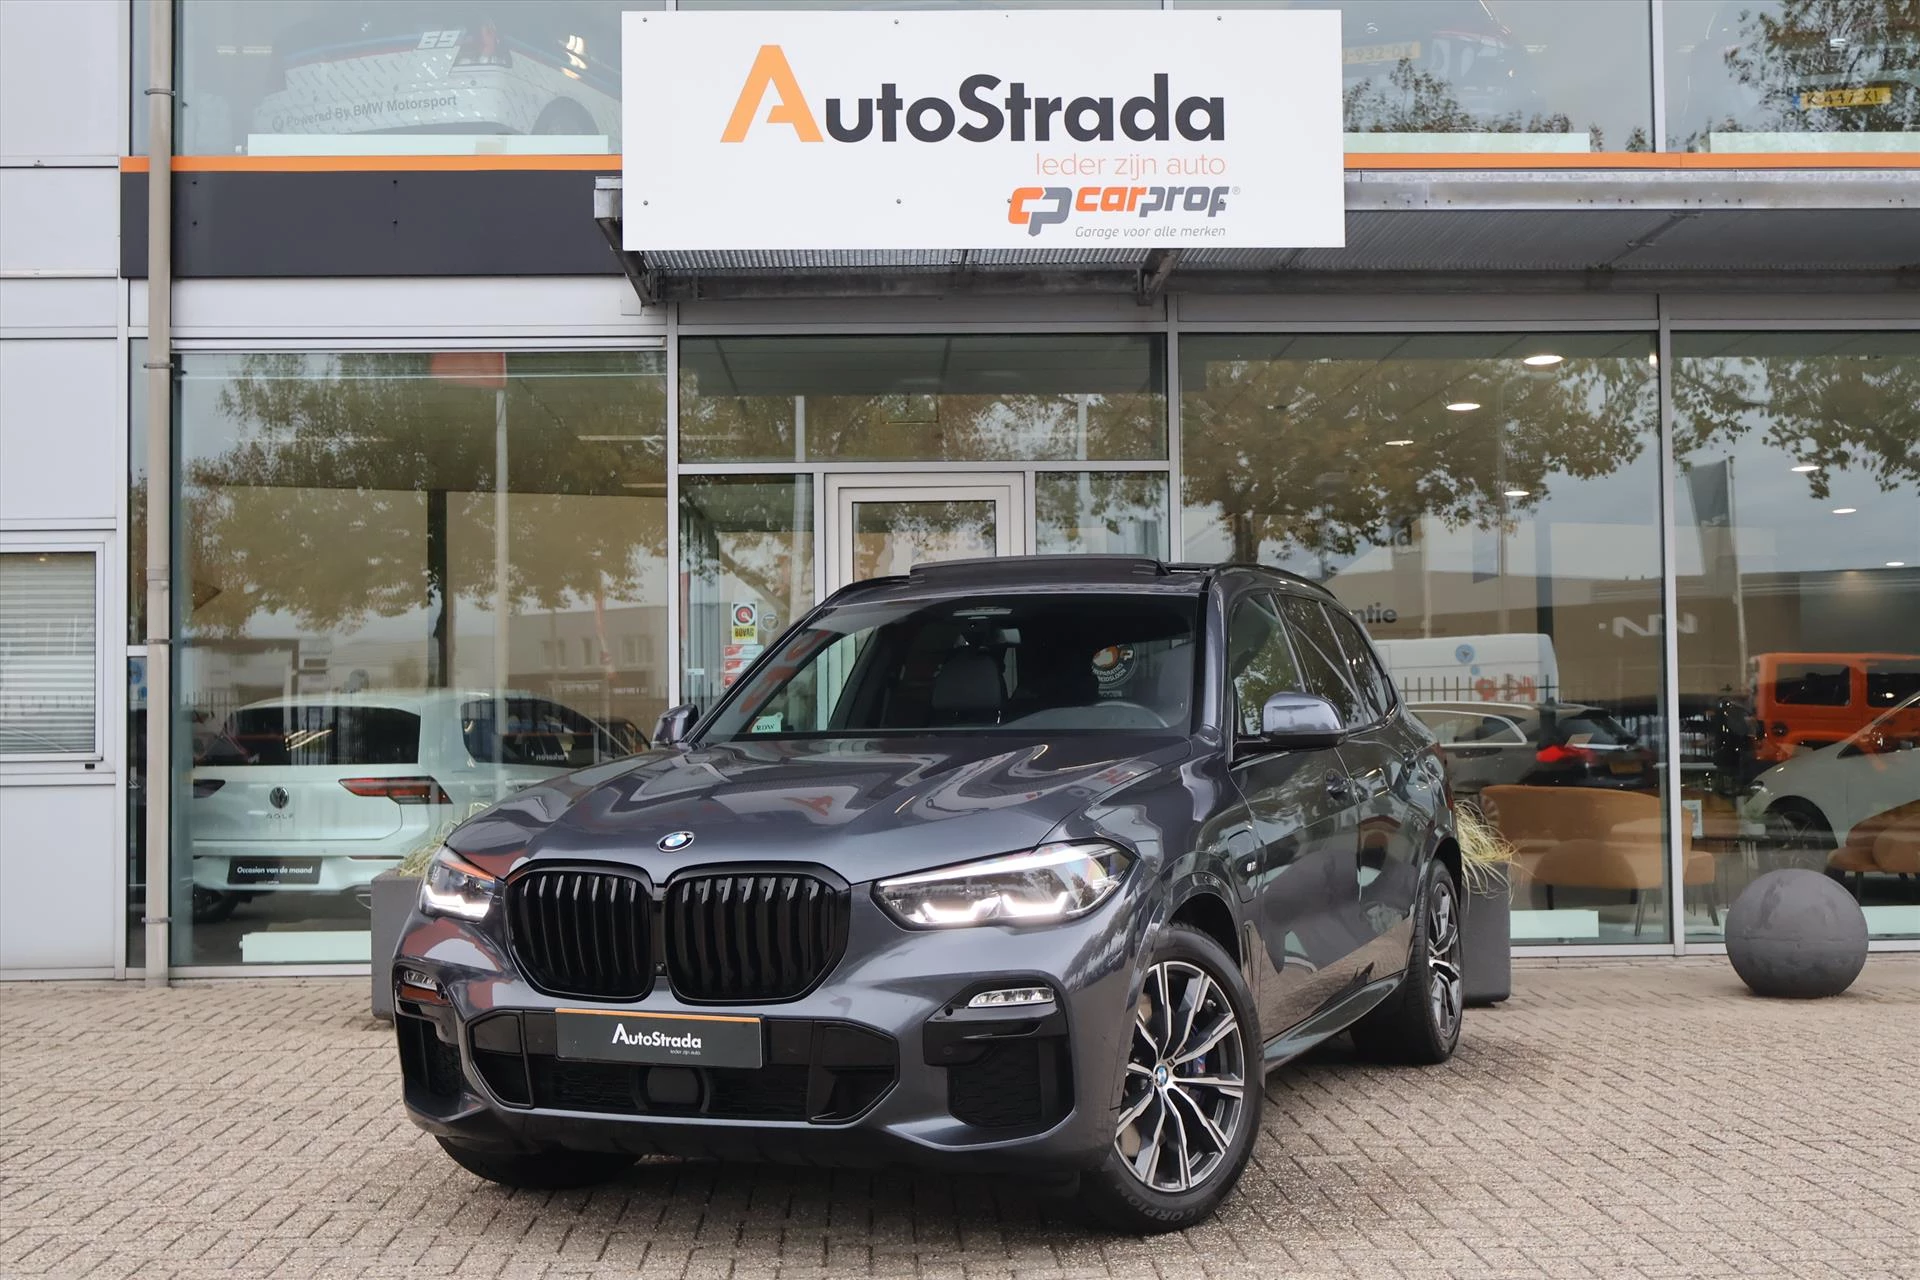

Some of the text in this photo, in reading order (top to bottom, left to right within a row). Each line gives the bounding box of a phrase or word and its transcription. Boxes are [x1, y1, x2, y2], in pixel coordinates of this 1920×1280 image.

[417, 30, 461, 49] 69
[720, 44, 1225, 143] AutoStrada
[286, 95, 457, 127] Powered By BMW Motorsport
[1036, 153, 1226, 181] Ieder zijn auto
[1075, 186, 1230, 218] carprof
[1075, 226, 1226, 240] Garage voor alle merken
[735, 627, 755, 638] BOVAG
[236, 866, 265, 874] Occasion
[280, 866, 288, 874] de
[289, 866, 313, 874] maand
[611, 1023, 702, 1049] AutoStrada
